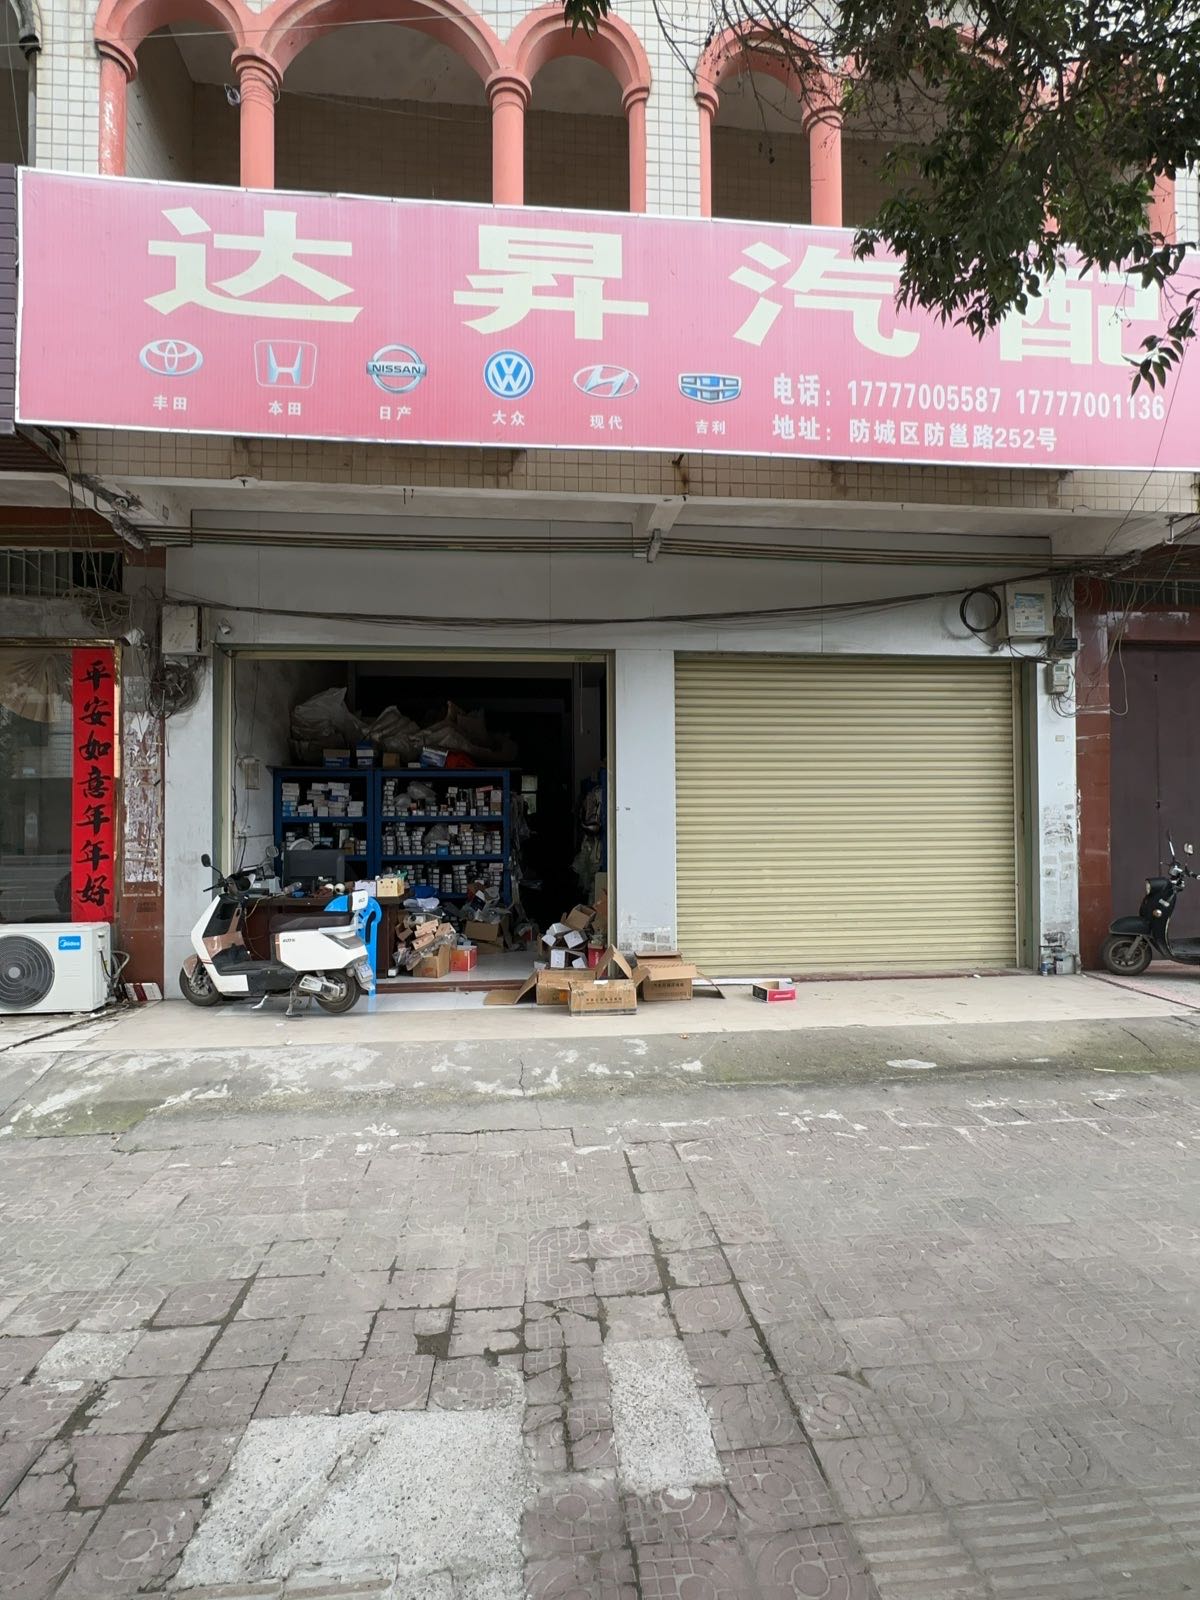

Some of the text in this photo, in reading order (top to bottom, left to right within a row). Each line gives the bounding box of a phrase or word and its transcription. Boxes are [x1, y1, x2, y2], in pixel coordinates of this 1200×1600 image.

[372, 364, 422, 375] NISSAN
[152, 395, 187, 411] 丰田
[268, 400, 301, 416] 本田
[1016, 388, 1165, 421] 17777001136
[379, 405, 412, 421] 日产
[492, 410, 525, 426] 大众
[590, 415, 623, 430] 现代
[695, 419, 726, 435] 吉利
[76, 659, 112, 907] 平安如意年年好
